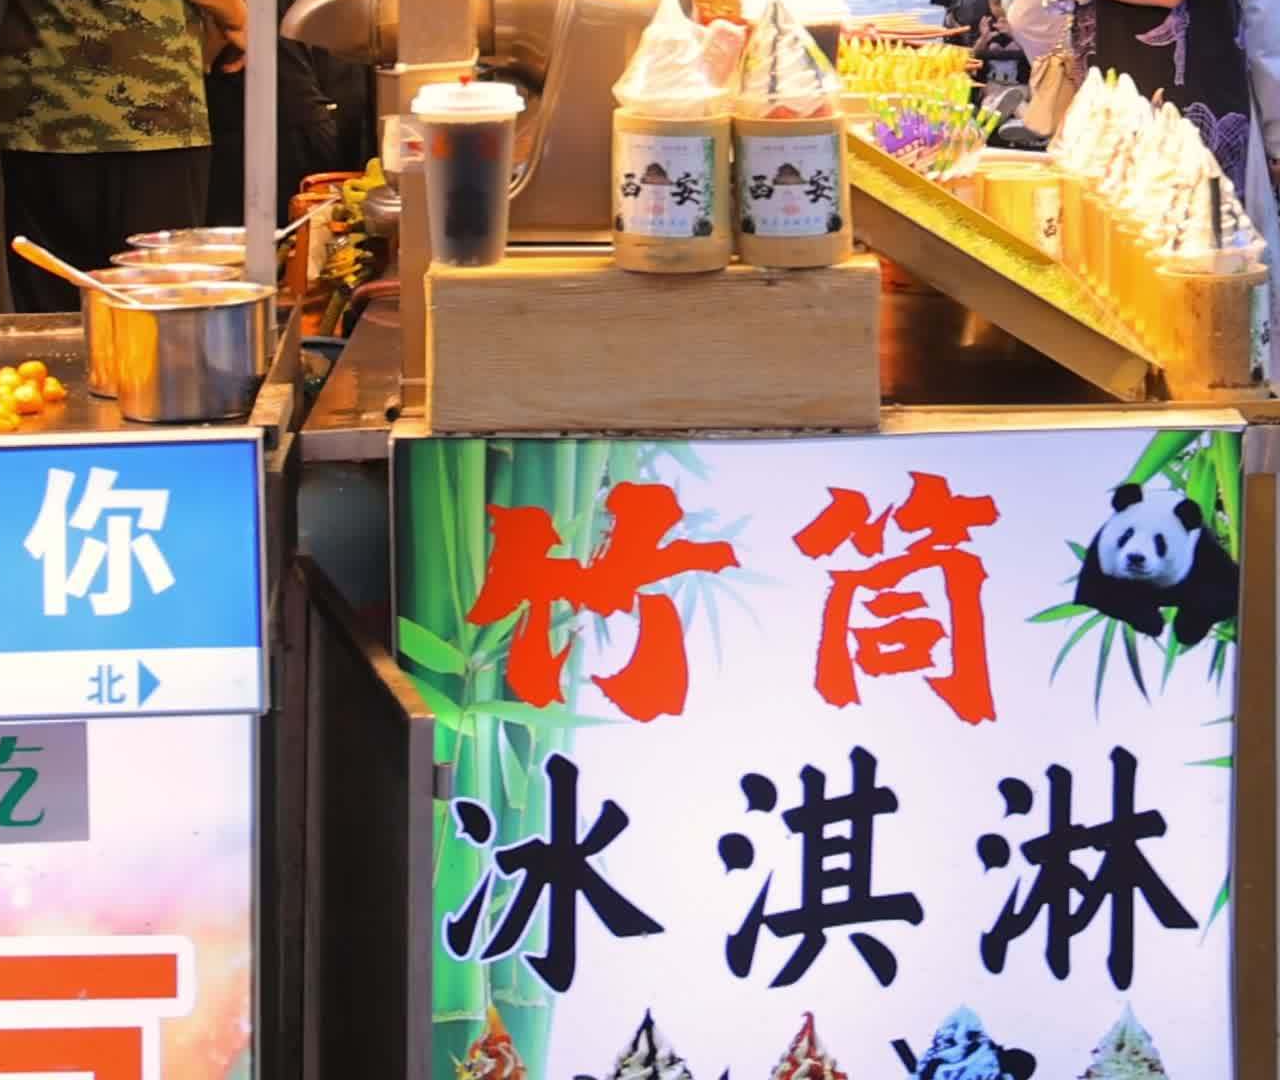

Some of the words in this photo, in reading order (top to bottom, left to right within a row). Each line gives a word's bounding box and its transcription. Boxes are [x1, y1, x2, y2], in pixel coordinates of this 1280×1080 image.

[748, 170, 834, 204] 西安
[464, 469, 1001, 726] 竹筒
[86, 663, 127, 706] 北
[443, 744, 1202, 995] 冰淇淋
